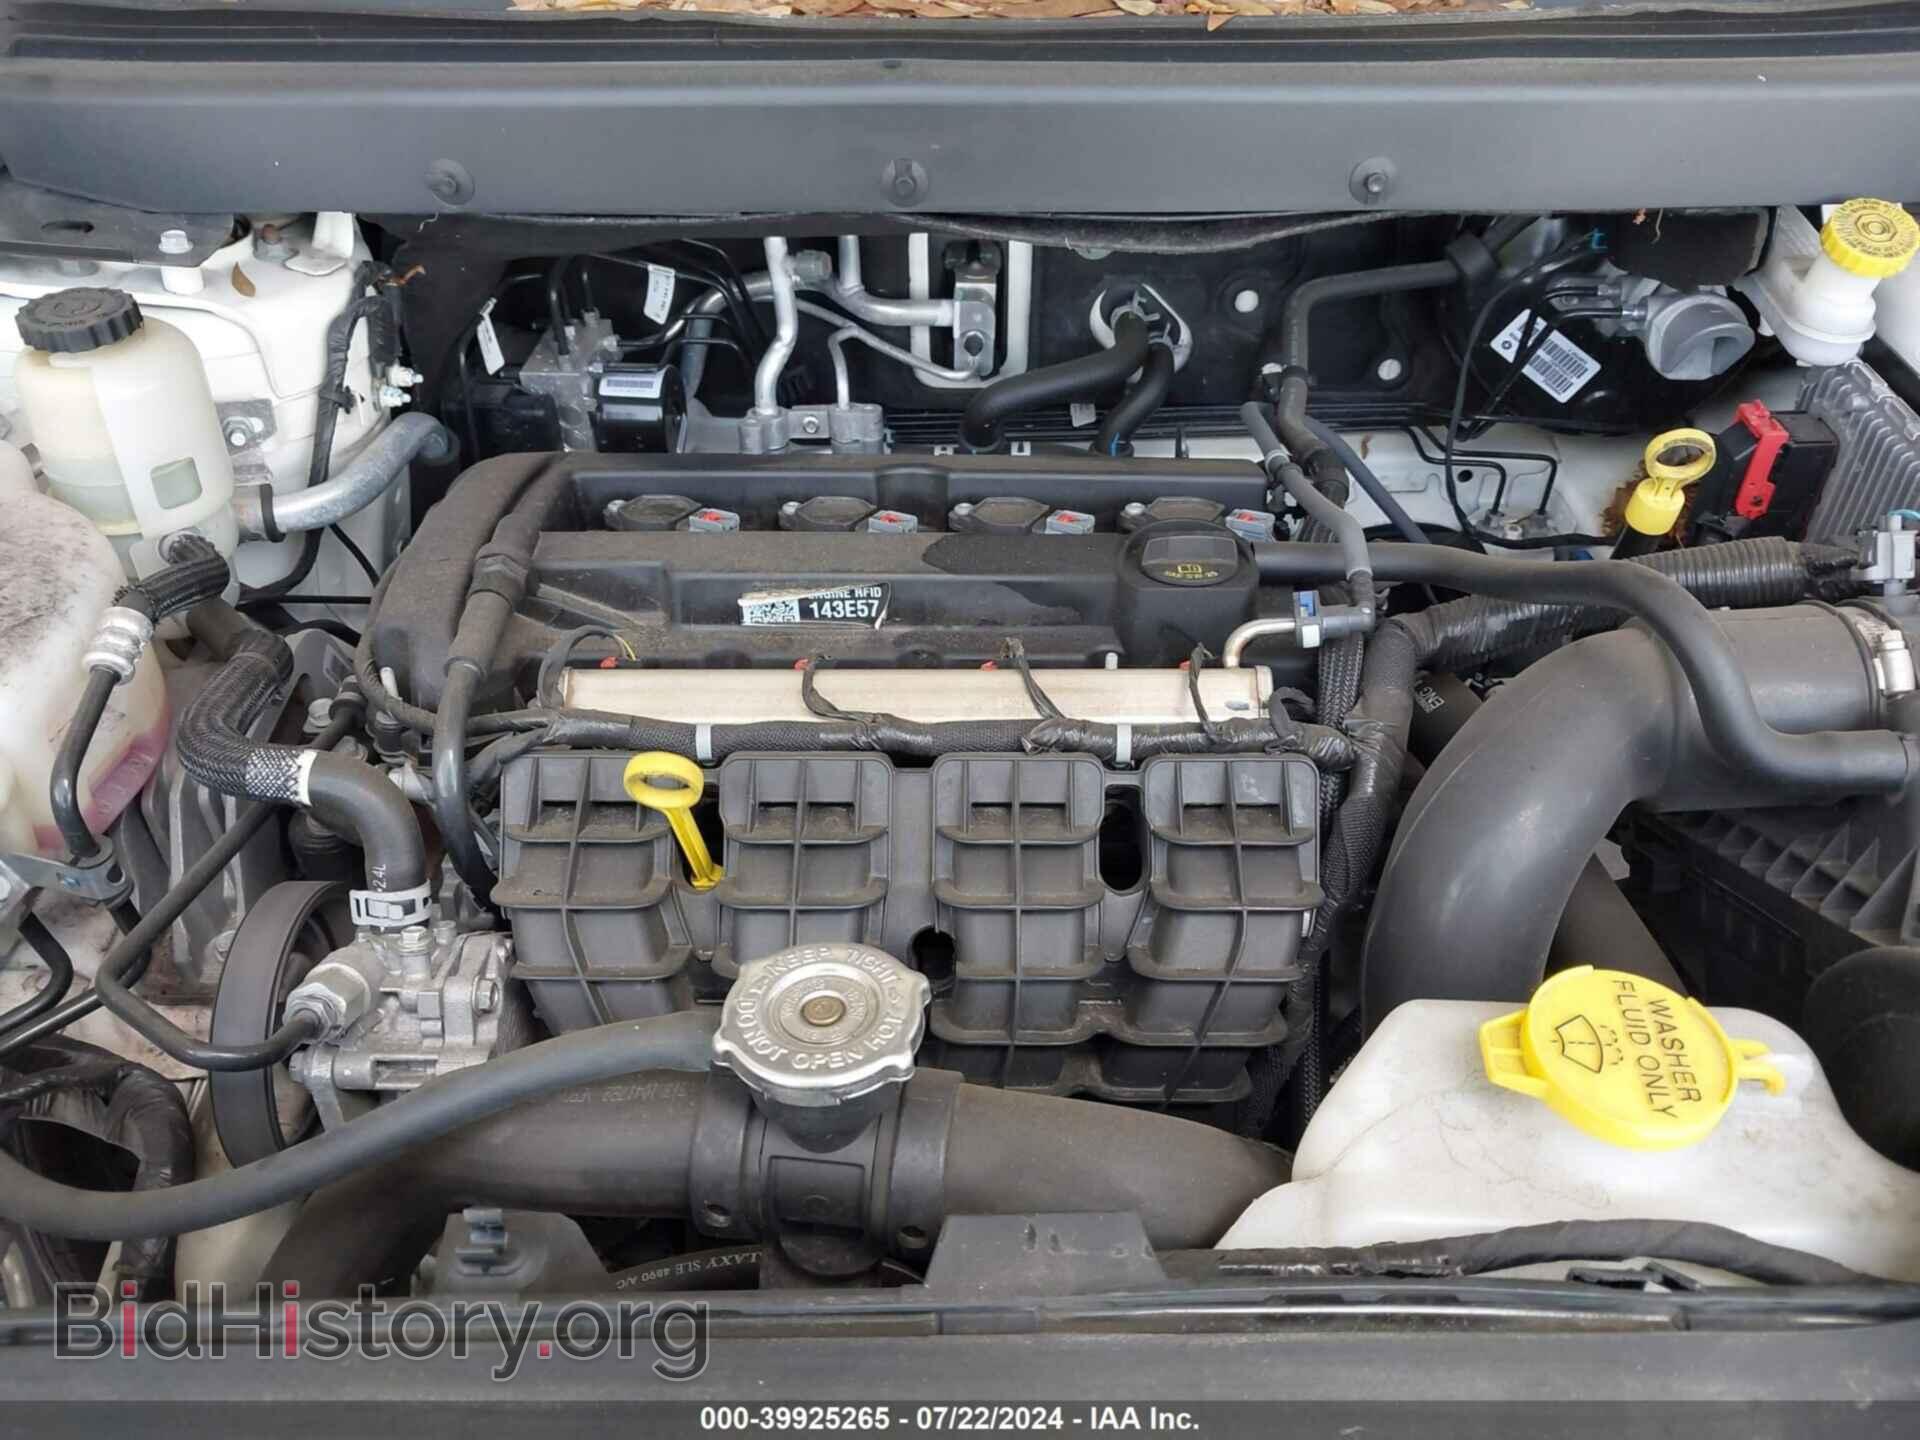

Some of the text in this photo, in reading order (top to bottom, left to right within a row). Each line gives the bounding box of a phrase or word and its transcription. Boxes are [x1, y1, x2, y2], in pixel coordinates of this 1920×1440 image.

[855, 587, 882, 598] RFID
[809, 600, 879, 618] 143E57
[372, 864, 386, 888] 2.4L
[767, 948, 895, 983] KEEP TIGHT
[736, 999, 758, 1028] DO
[742, 1030, 788, 1061] NOT
[863, 1017, 903, 1050] HOT
[791, 1050, 863, 1069] OPEN
[1612, 979, 1679, 1118] FLUID ONLY
[1648, 999, 1702, 1102] WASHER
[705, 1252, 763, 1269] LAXY
